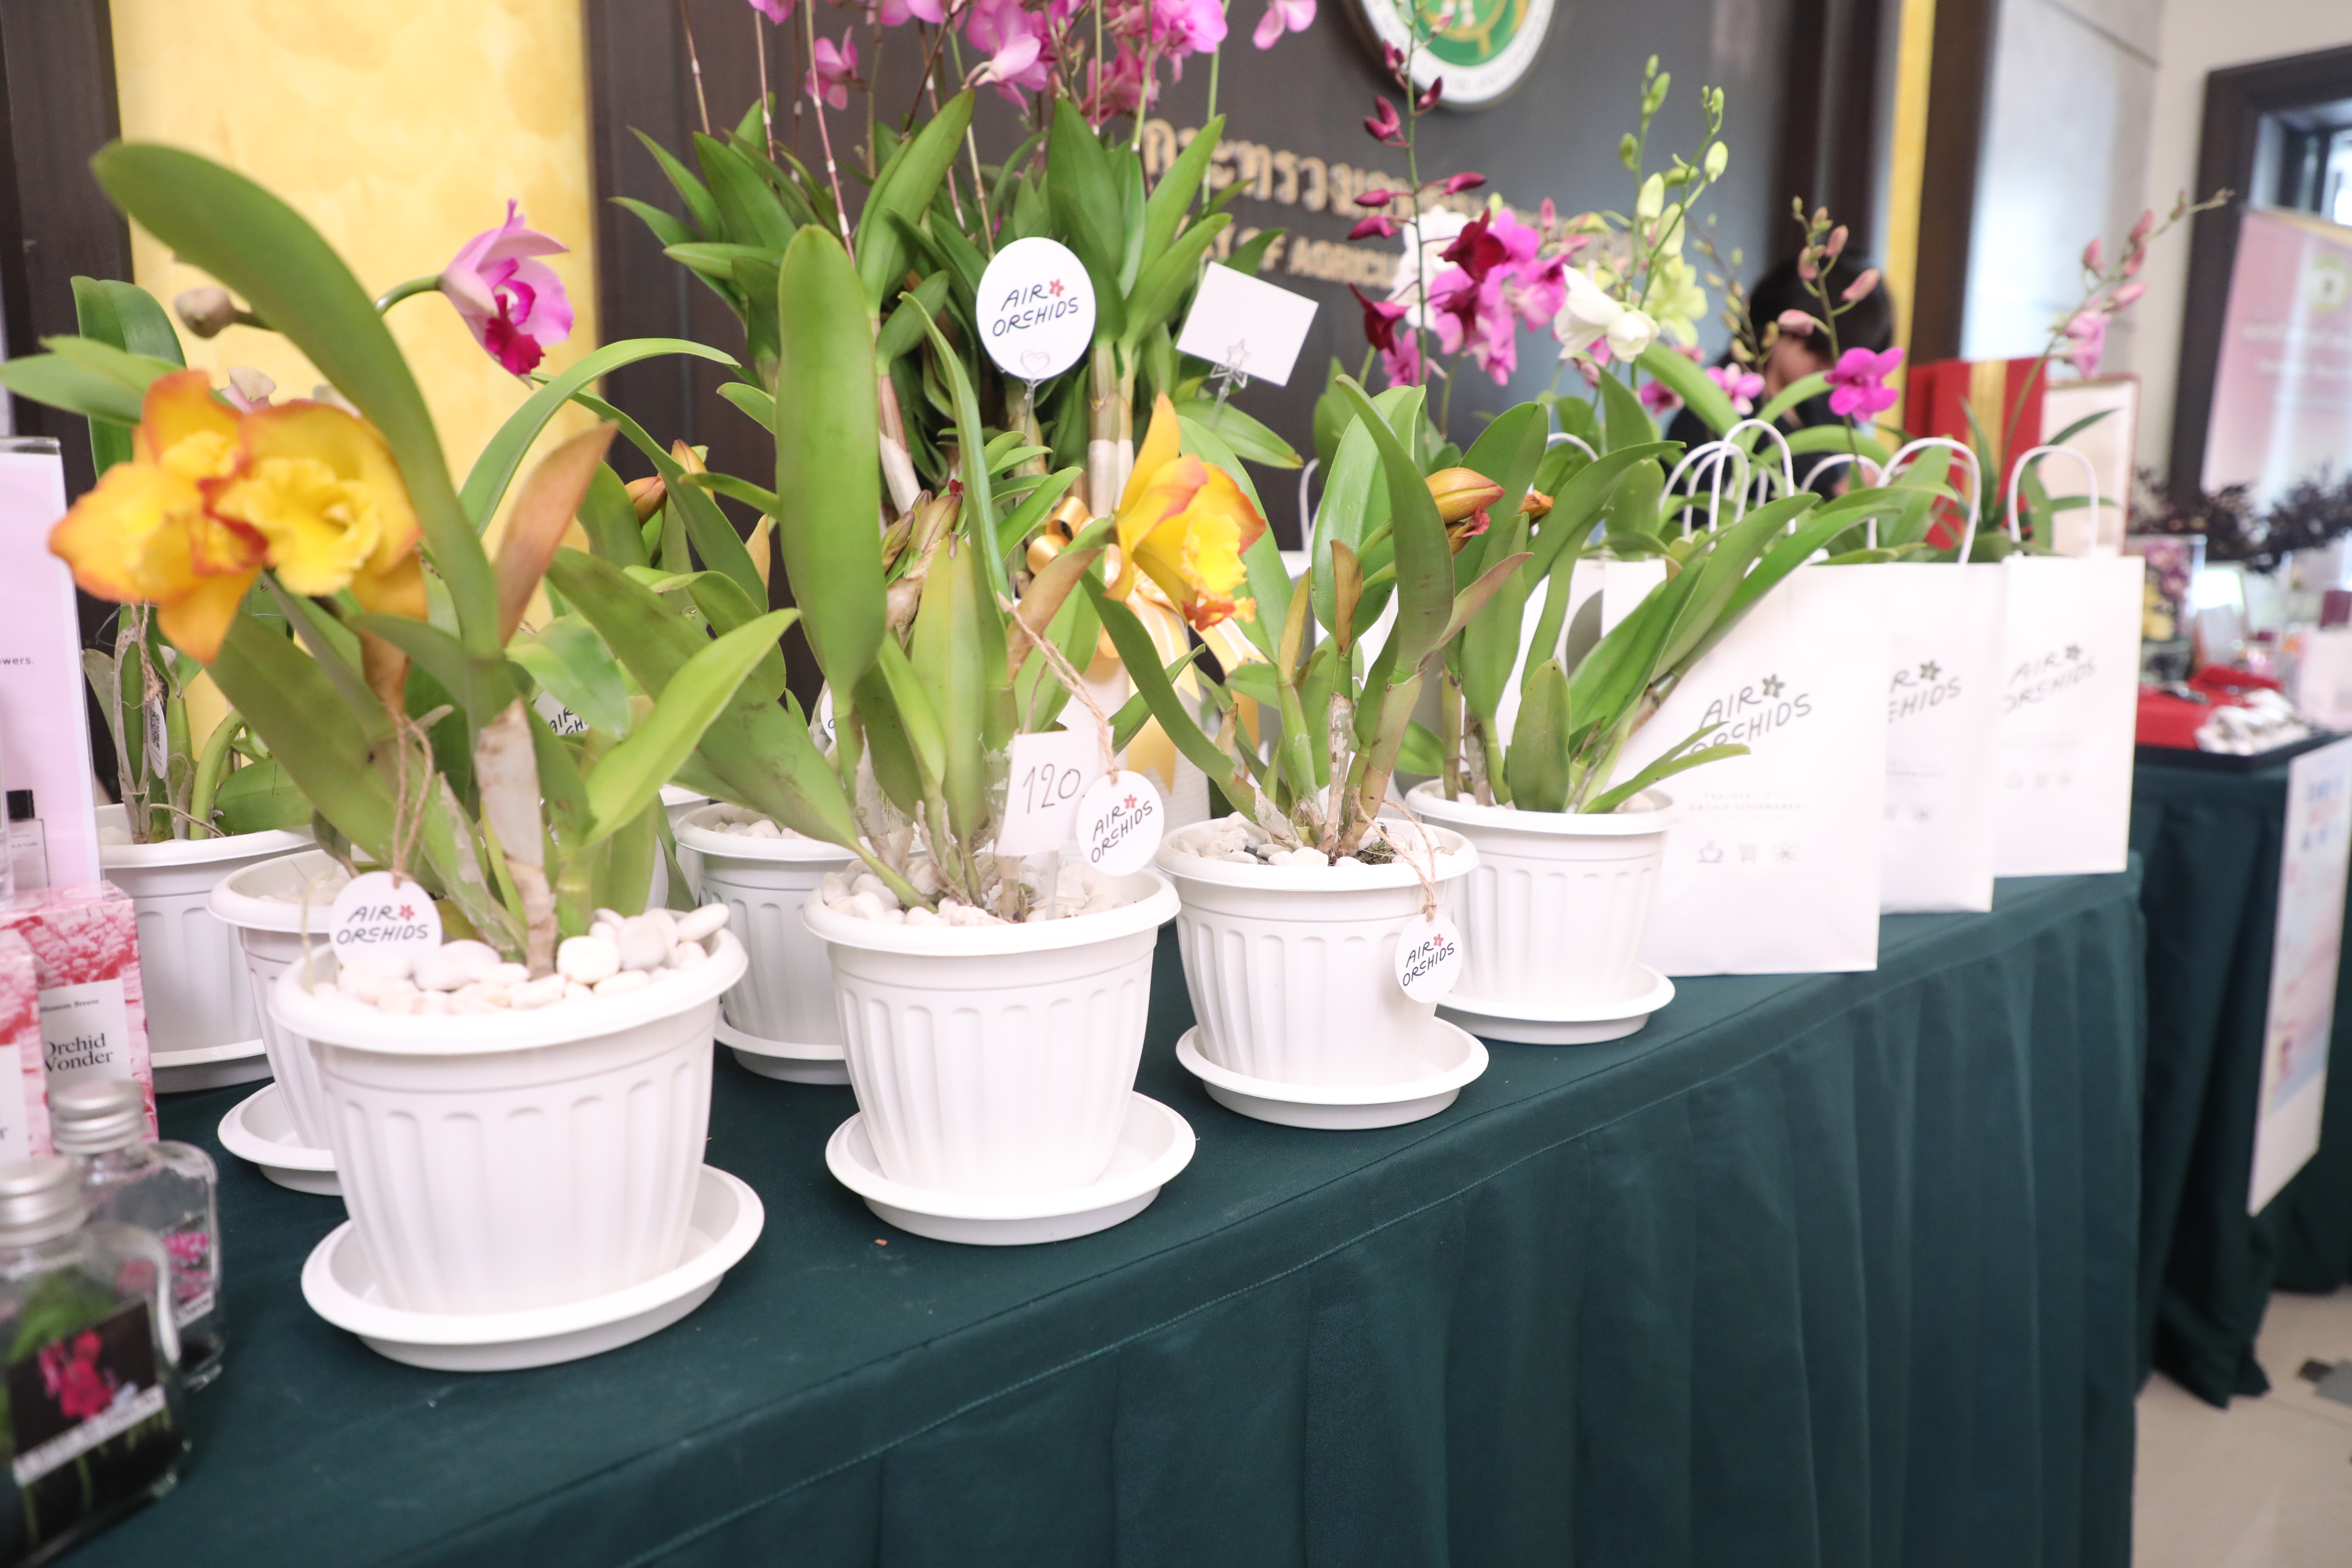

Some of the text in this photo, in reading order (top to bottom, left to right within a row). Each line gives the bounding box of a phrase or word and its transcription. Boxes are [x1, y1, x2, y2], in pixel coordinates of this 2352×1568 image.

[1001, 283, 1048, 311] AIR
[993, 297, 1079, 337] ORCHIDS
[1700, 686, 1762, 730] AIR
[1022, 763, 1086, 814] 120
[1091, 800, 1153, 863] ORCHIDS
[1093, 806, 1125, 842] AIR
[347, 905, 397, 924] AIR
[337, 924, 429, 945] ORCHIDS
[1403, 942, 1455, 986] ORCHIDS
[1406, 941, 1434, 968] AIR
